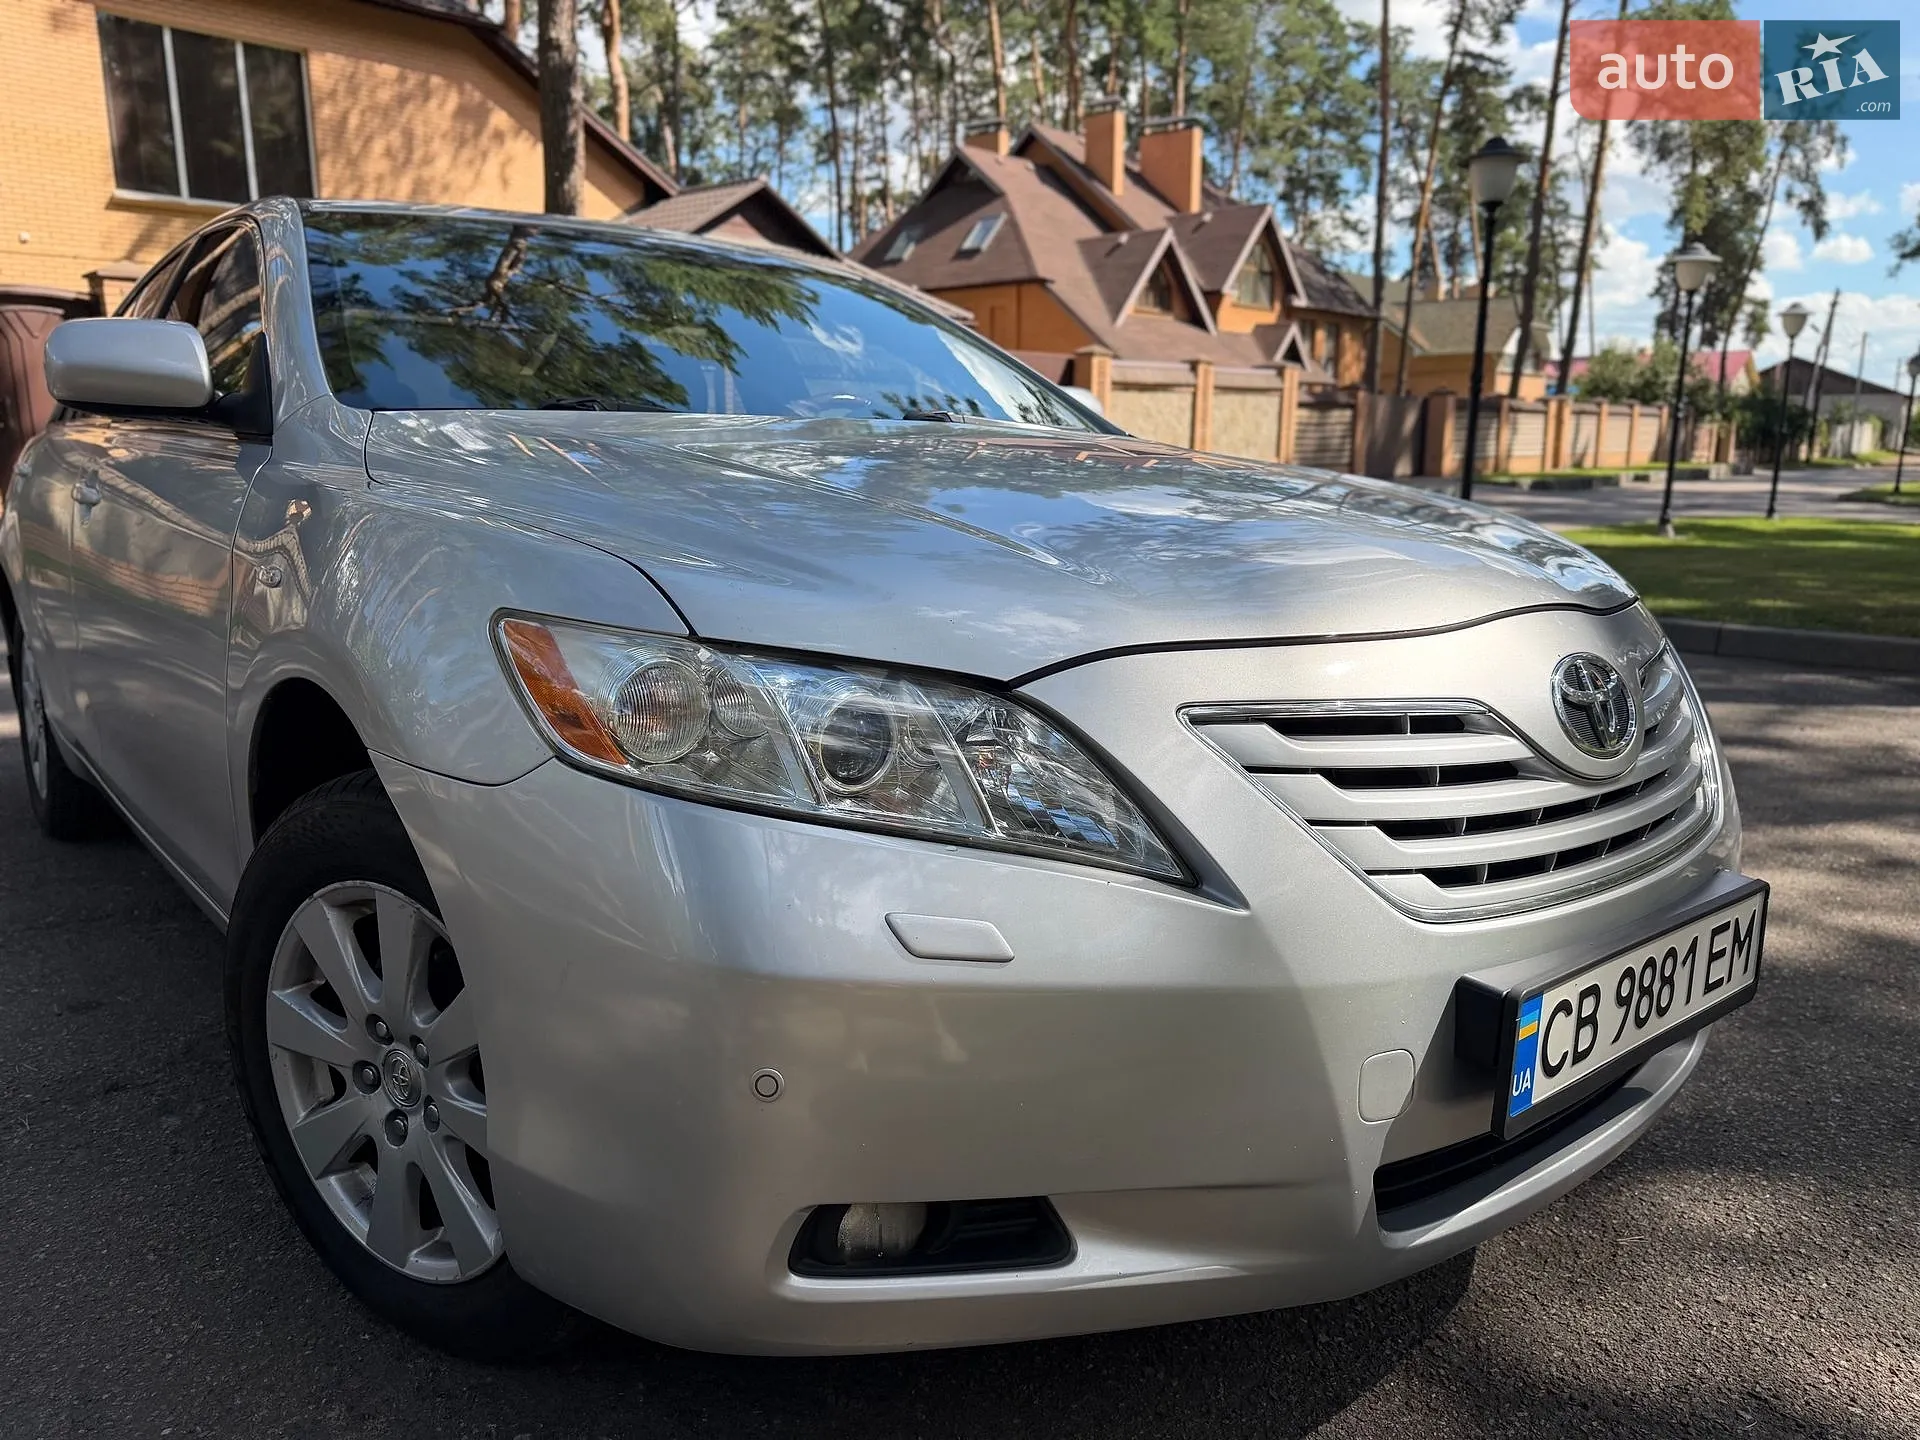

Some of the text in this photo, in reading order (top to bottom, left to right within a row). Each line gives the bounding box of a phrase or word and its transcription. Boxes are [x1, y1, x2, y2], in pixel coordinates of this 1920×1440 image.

[1540, 908, 1757, 1079] CB 9881 EM
[1511, 1067, 1531, 1097] UA
